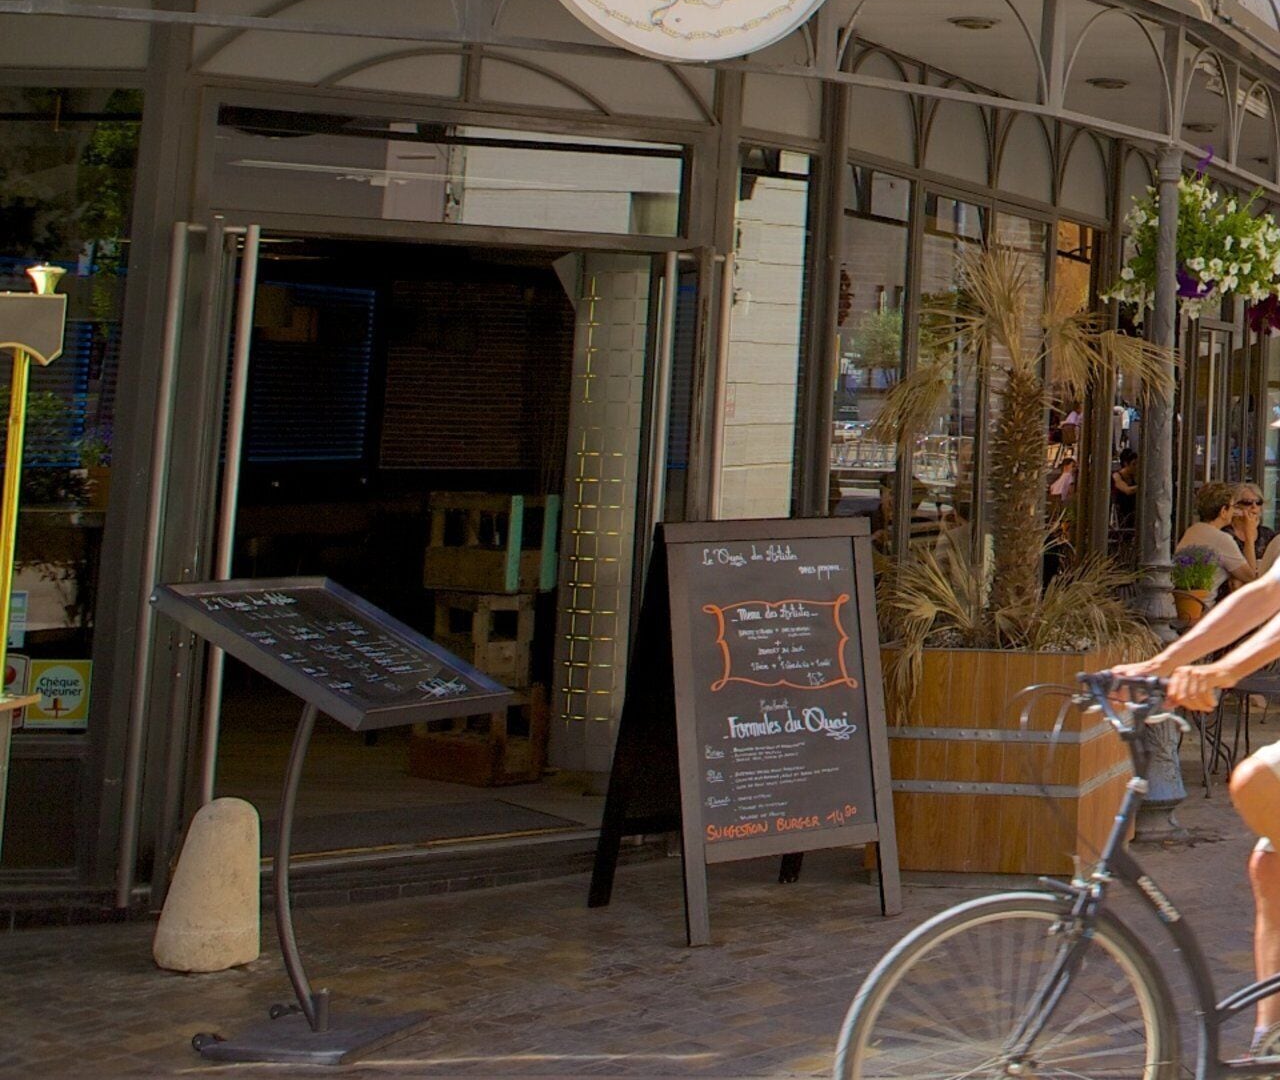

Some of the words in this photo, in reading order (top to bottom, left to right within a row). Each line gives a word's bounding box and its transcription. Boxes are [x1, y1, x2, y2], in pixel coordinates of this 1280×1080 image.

[702, 549, 714, 566] Le
[713, 548, 747, 567] Quai
[766, 545, 798, 563] Artistes
[727, 712, 782, 739] Formules
[784, 709, 805, 733] du
[802, 707, 857, 740] Quai
[706, 821, 769, 841] SUGGESTION
[776, 816, 820, 832] BURGER
